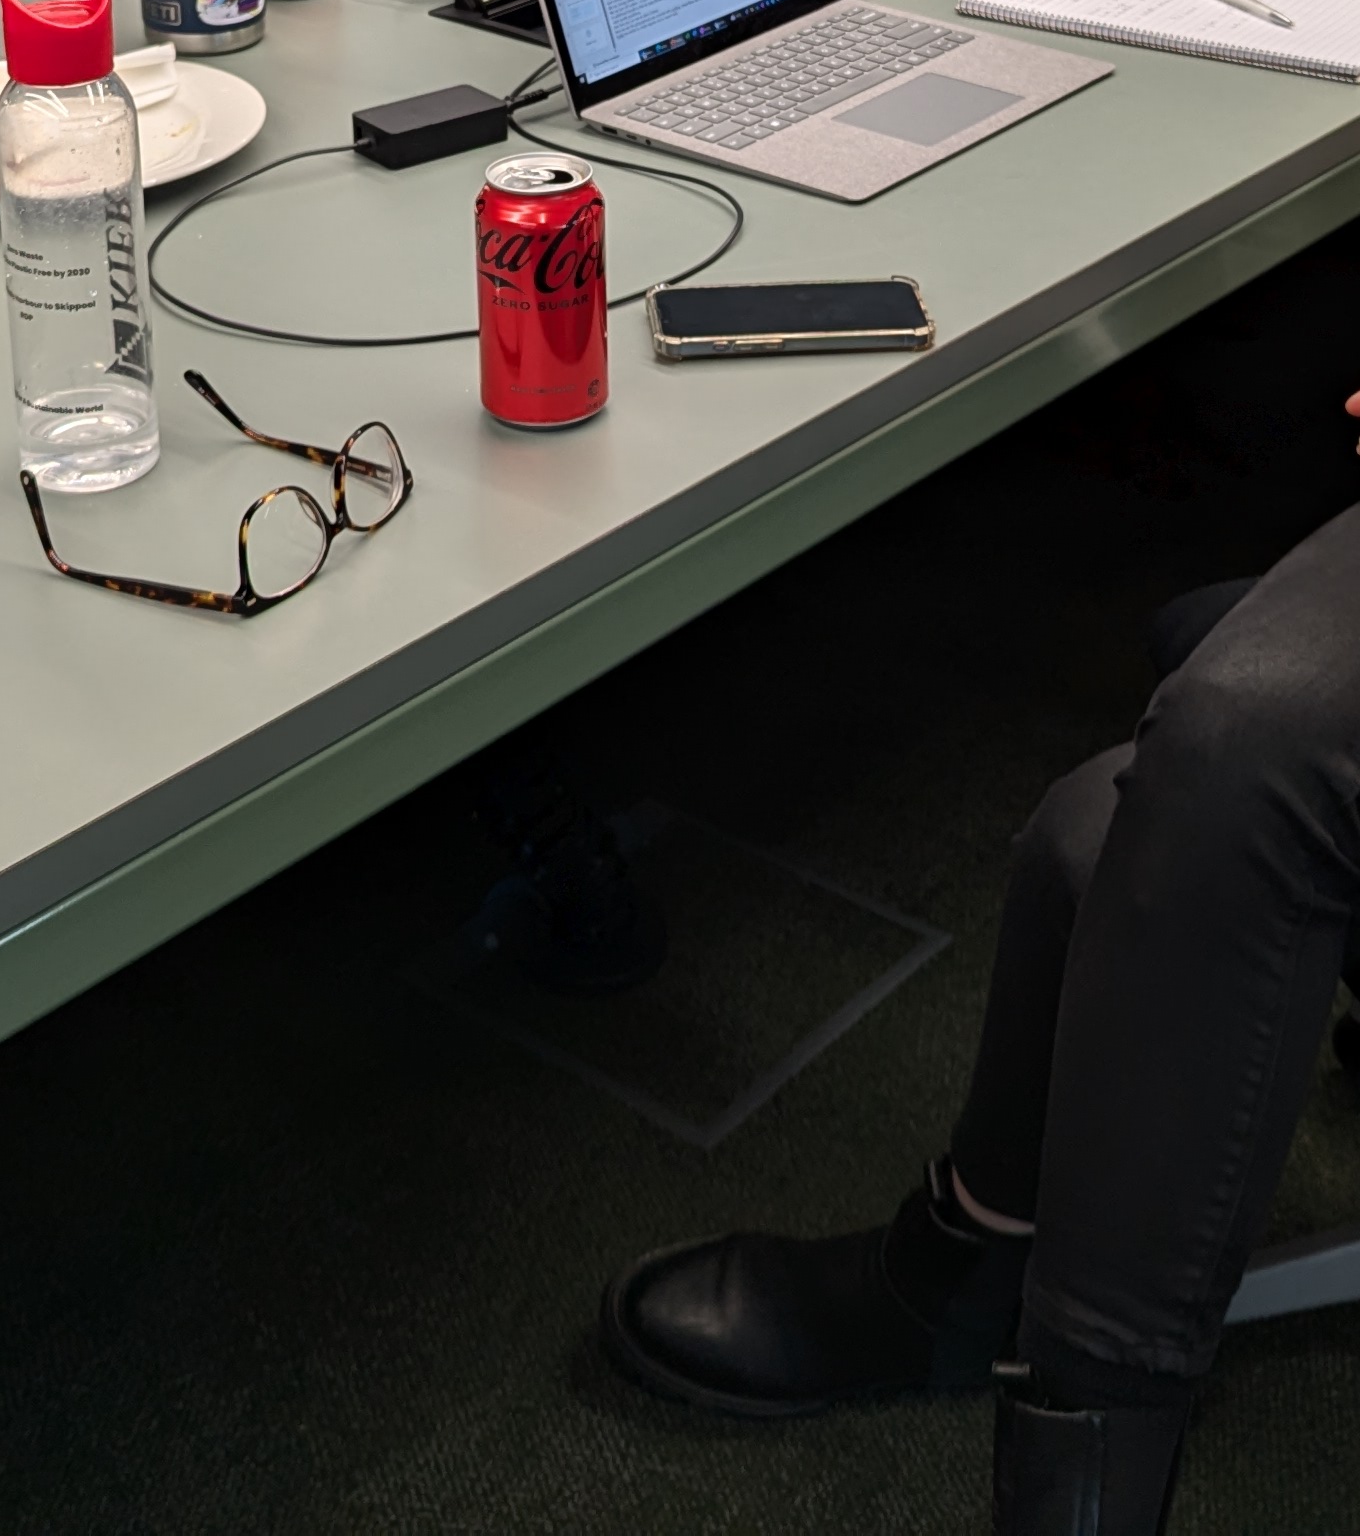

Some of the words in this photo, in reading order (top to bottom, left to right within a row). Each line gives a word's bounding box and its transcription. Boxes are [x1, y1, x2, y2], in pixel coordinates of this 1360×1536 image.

[19, 250, 44, 261] Waste
[33, 267, 52, 277] Free
[53, 269, 66, 279] by
[67, 267, 91, 277] 2030
[44, 302, 54, 310] to
[54, 300, 96, 312] Skippool
[491, 294, 531, 312] ZERO
[537, 293, 590, 312] SUGAR
[75, 404, 104, 414] World
